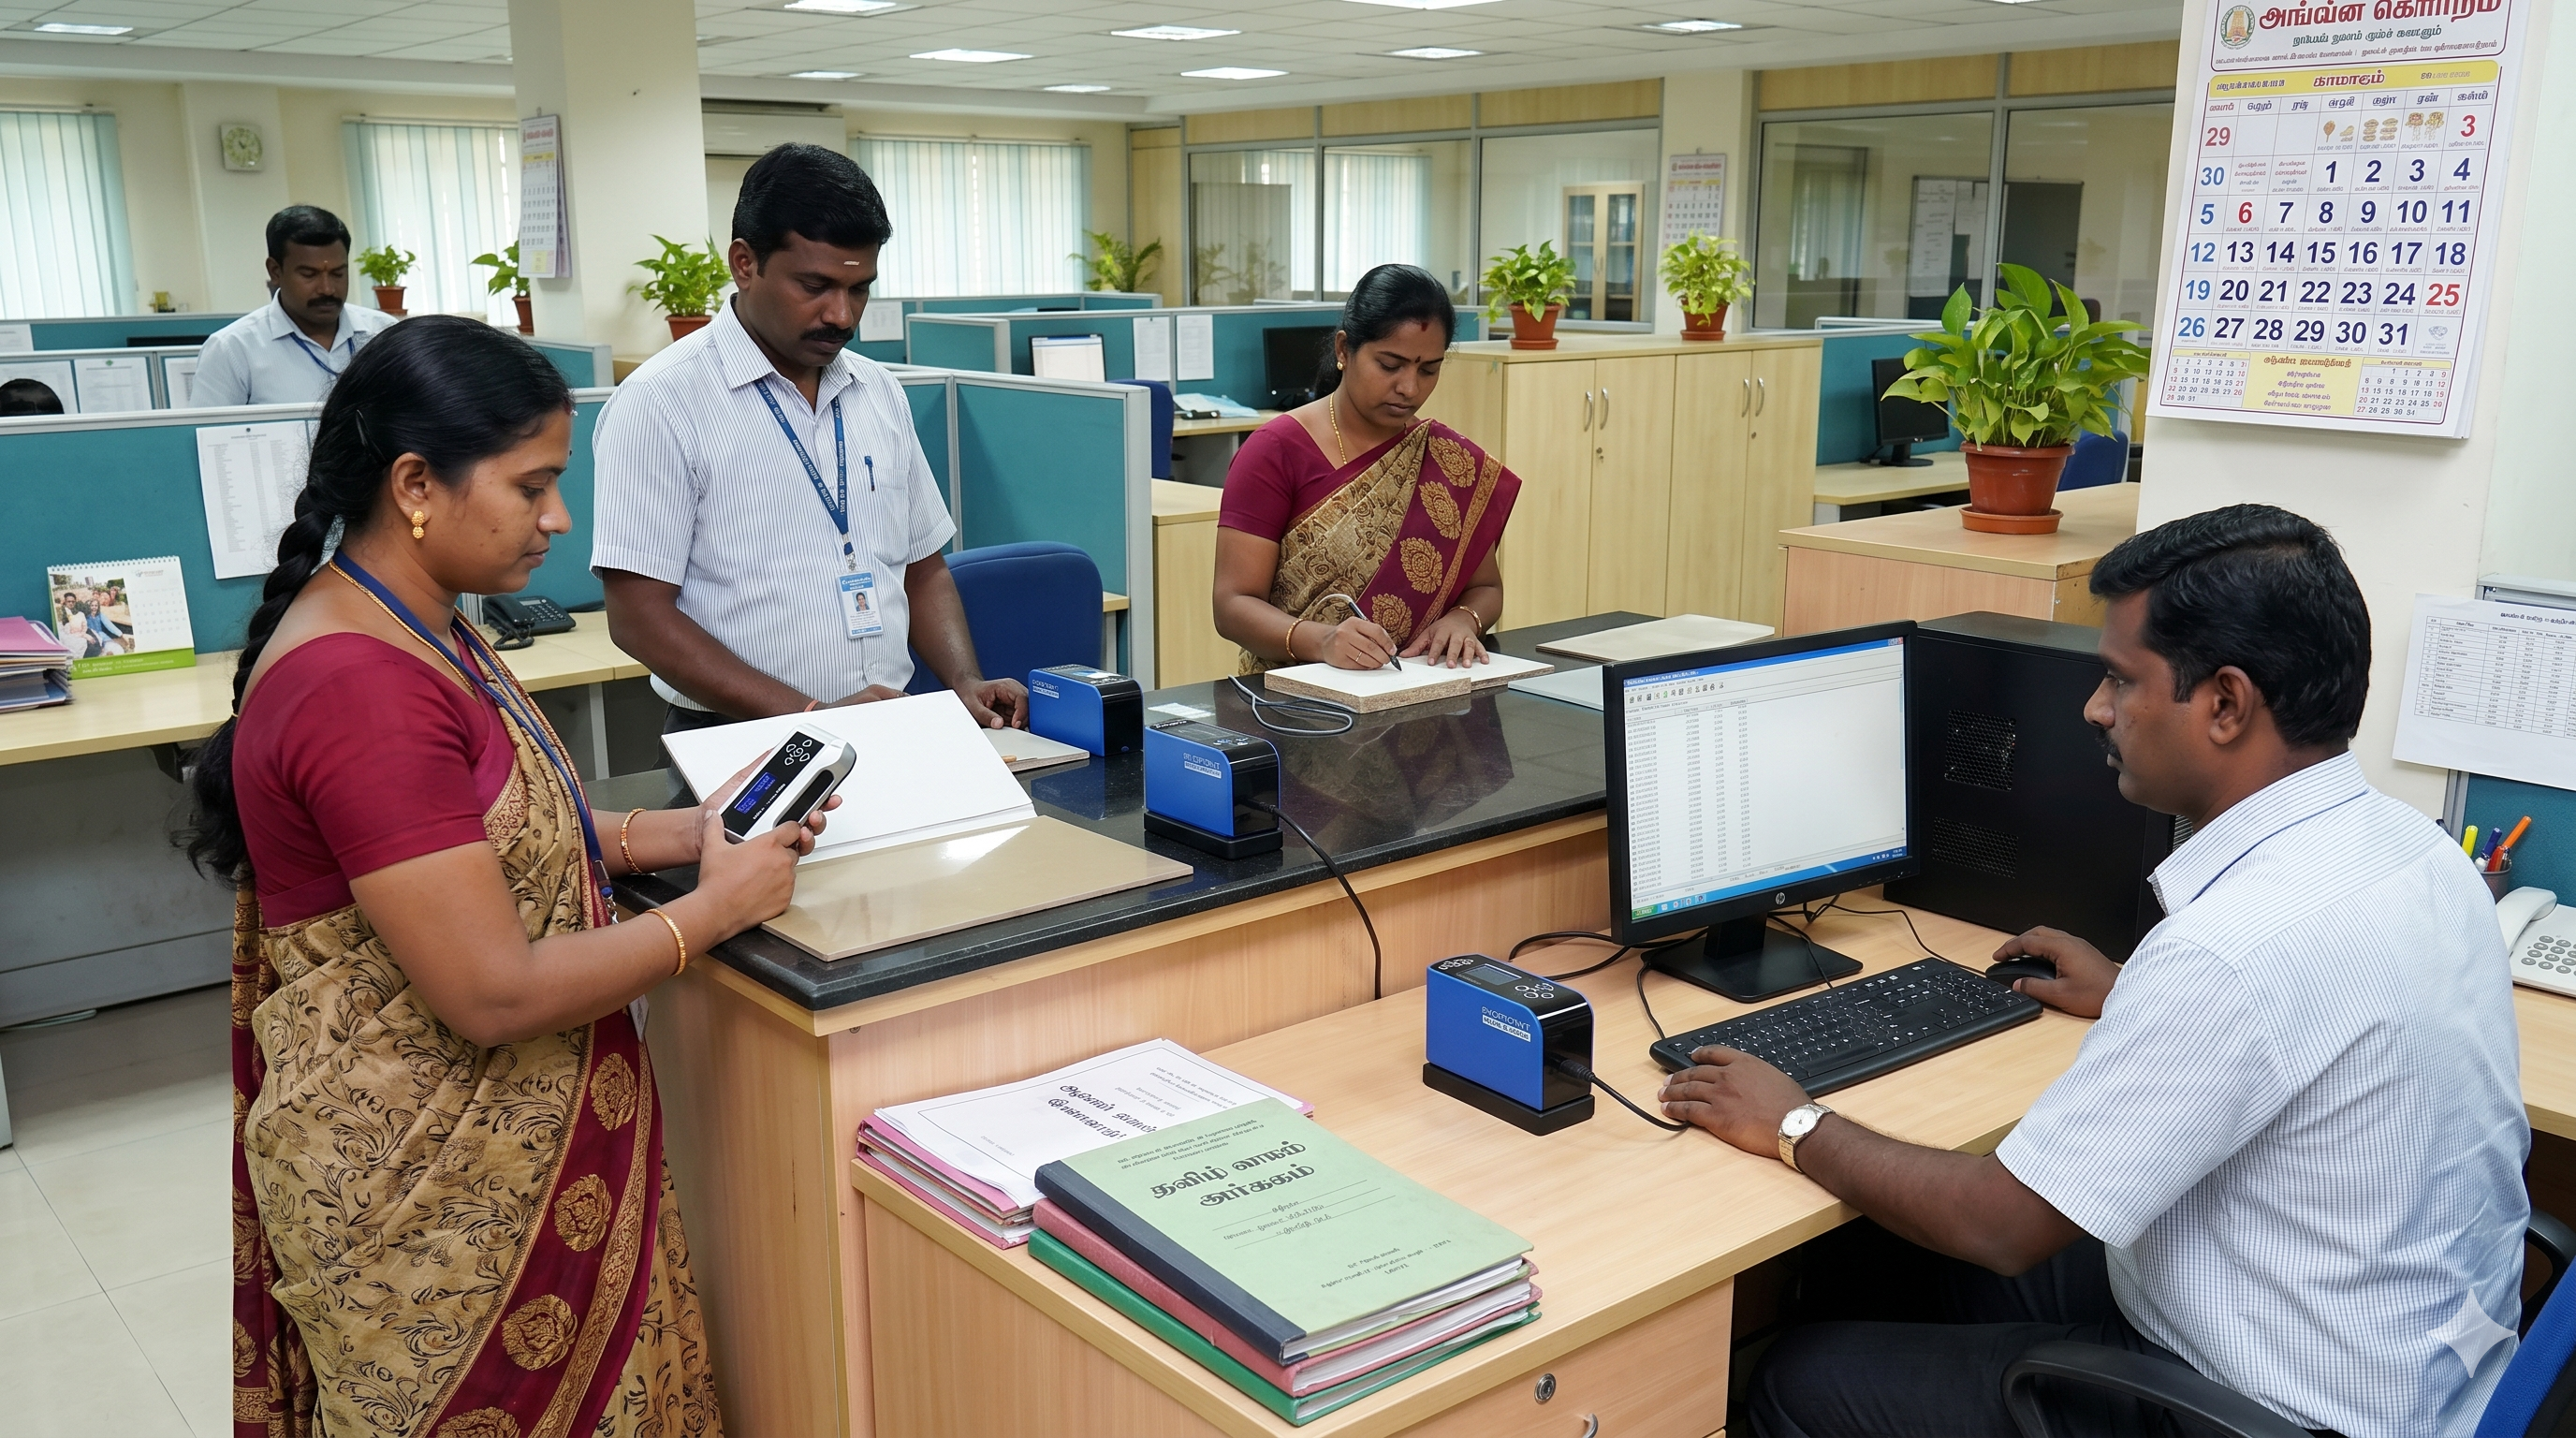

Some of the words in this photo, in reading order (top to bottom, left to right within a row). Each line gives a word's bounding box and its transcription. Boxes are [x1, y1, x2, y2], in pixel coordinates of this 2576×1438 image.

[2205, 126, 2231, 147] 29
[2460, 114, 2476, 138] 3
[2201, 167, 2225, 186] 30
[2325, 160, 2337, 183] 1
[2364, 159, 2382, 183] 2
[2408, 158, 2425, 183] 3
[2452, 157, 2471, 182] 4
[2200, 203, 2215, 225] 5
[2238, 201, 2253, 224] 6
[2279, 201, 2294, 224] 7
[2319, 200, 2334, 224] 8
[2360, 200, 2377, 224] 9
[2397, 199, 2427, 224] 10
[2441, 199, 2470, 224] 11
[2190, 242, 2216, 262] 12
[2227, 241, 2254, 263] 13
[2266, 241, 2295, 263] 14
[2306, 241, 2336, 264] 15
[2349, 241, 2378, 265] 16
[2391, 242, 2423, 265] 17
[2435, 242, 2466, 266] 18
[2186, 279, 2211, 301] 19
[2218, 279, 2249, 301] 20
[2258, 280, 2288, 302] 21
[2299, 280, 2331, 303] 22
[2340, 281, 2372, 305] 23
[2382, 282, 2416, 305] 24
[2425, 283, 2461, 307] 25
[2177, 316, 2205, 338] 26
[2214, 316, 2246, 339] 27
[2252, 318, 2284, 341] 28
[2293, 319, 2325, 343] 29
[2334, 321, 2367, 345] 30
[2378, 322, 2408, 345] 31
